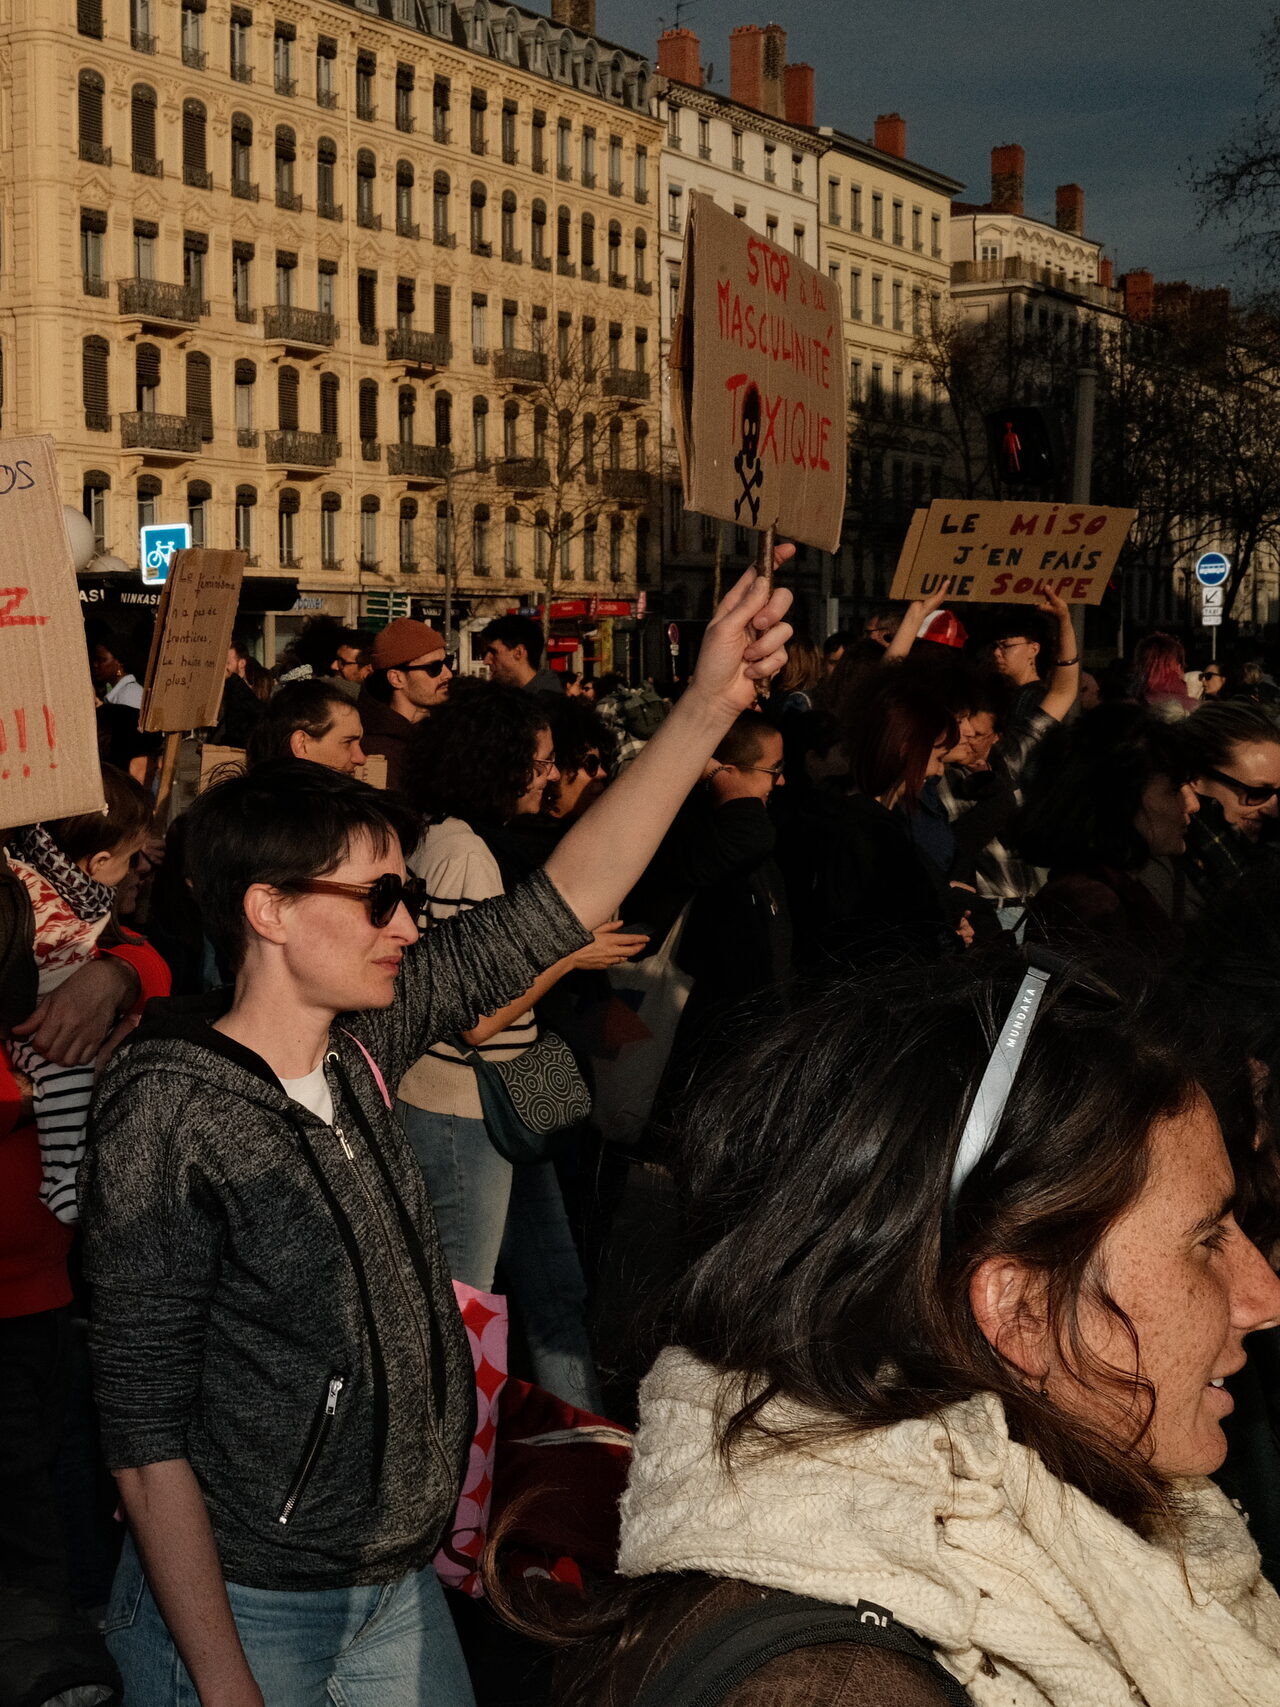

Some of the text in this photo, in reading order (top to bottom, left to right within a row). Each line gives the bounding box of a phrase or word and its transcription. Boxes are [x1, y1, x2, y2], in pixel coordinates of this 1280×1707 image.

[746, 236, 790, 304] STOP
[716, 278, 834, 389] MASCULINITÉ
[940, 513, 980, 535] LE
[989, 572, 1094, 599] SOUPE
[1005, 987, 1037, 1049] MUNDAKA
